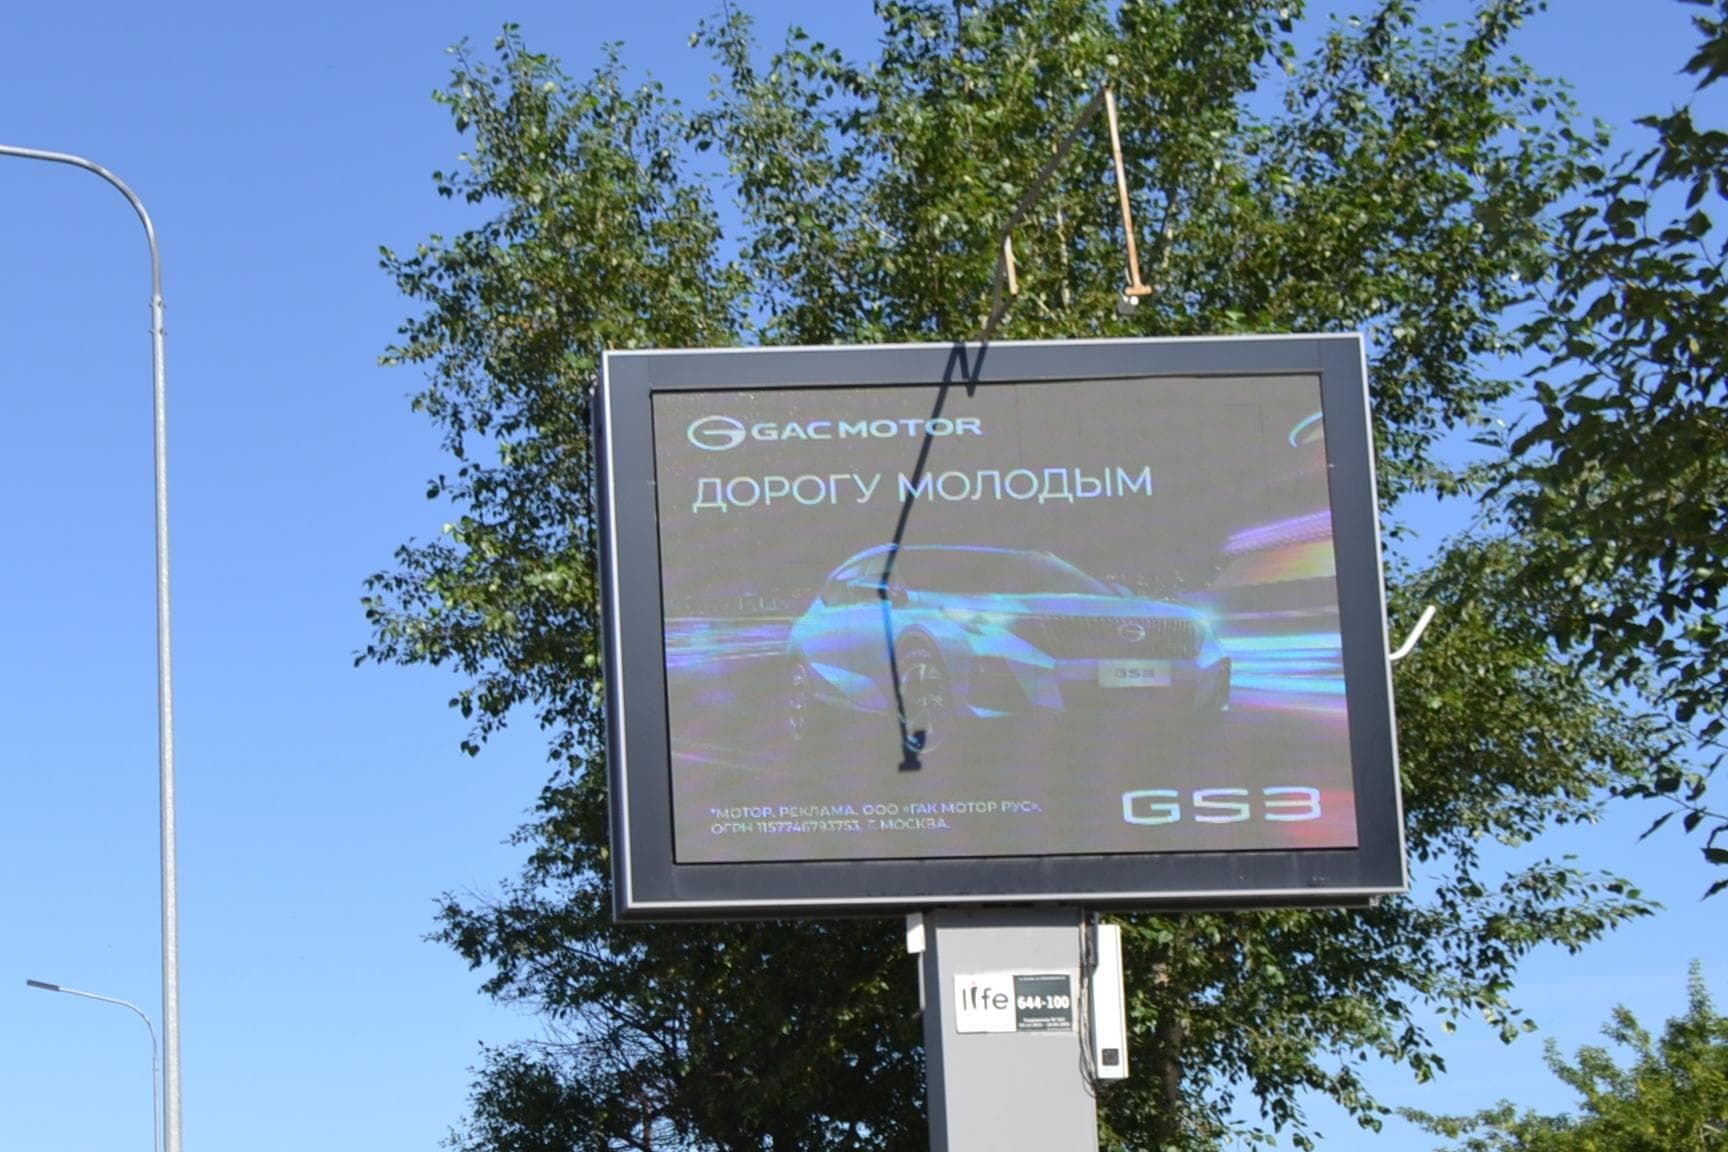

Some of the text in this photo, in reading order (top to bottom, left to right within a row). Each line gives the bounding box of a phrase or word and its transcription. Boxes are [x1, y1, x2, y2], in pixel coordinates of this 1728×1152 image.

[751, 418, 984, 441] GAC MOTOR
[692, 465, 1154, 513] ДОРОГУ МОЛОДЫМ
[862, 803, 900, 816] ООО
[941, 801, 998, 814] МОТОР
[1122, 786, 1322, 825] GS3
[710, 821, 754, 835] ОГРН
[1017, 994, 1071, 1010] 644-100
